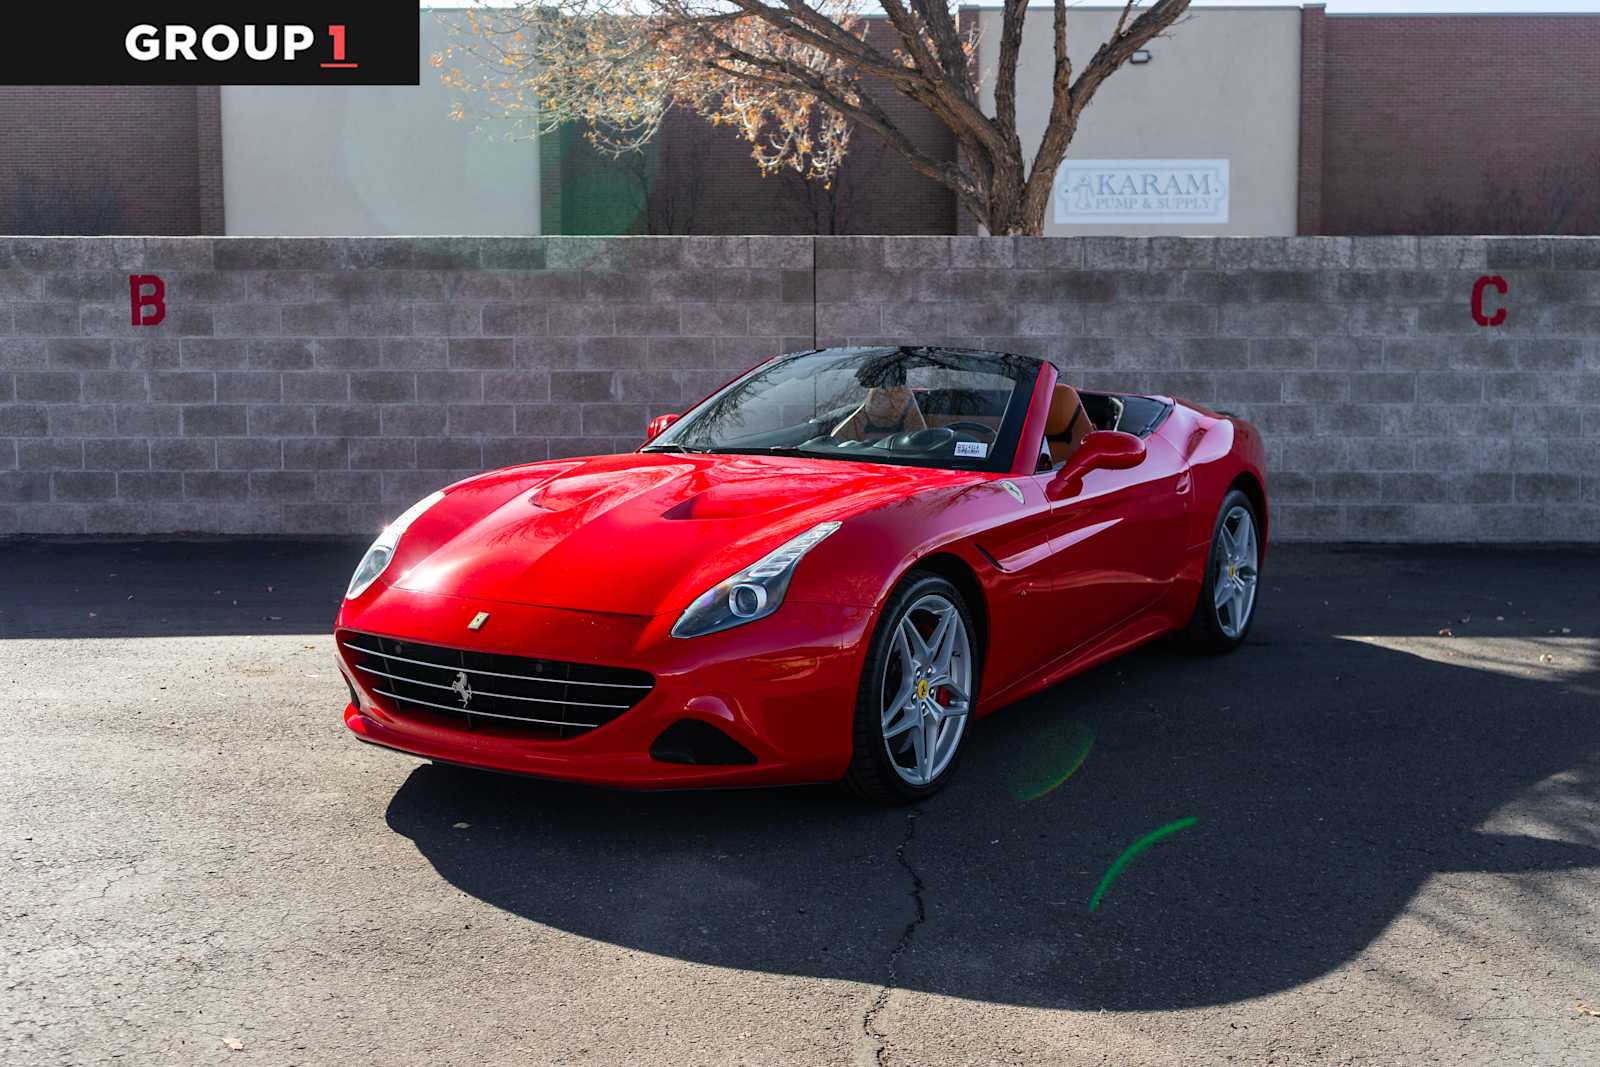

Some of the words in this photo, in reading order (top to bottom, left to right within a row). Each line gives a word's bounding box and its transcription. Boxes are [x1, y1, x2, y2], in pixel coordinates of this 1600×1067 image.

[1096, 174, 1211, 195] KARAM
[1095, 198, 1138, 209] PUMP
[1142, 198, 1153, 209] &
[1158, 198, 1210, 209] SUPPLY
[129, 275, 166, 326] B
[1471, 275, 1508, 326] C
